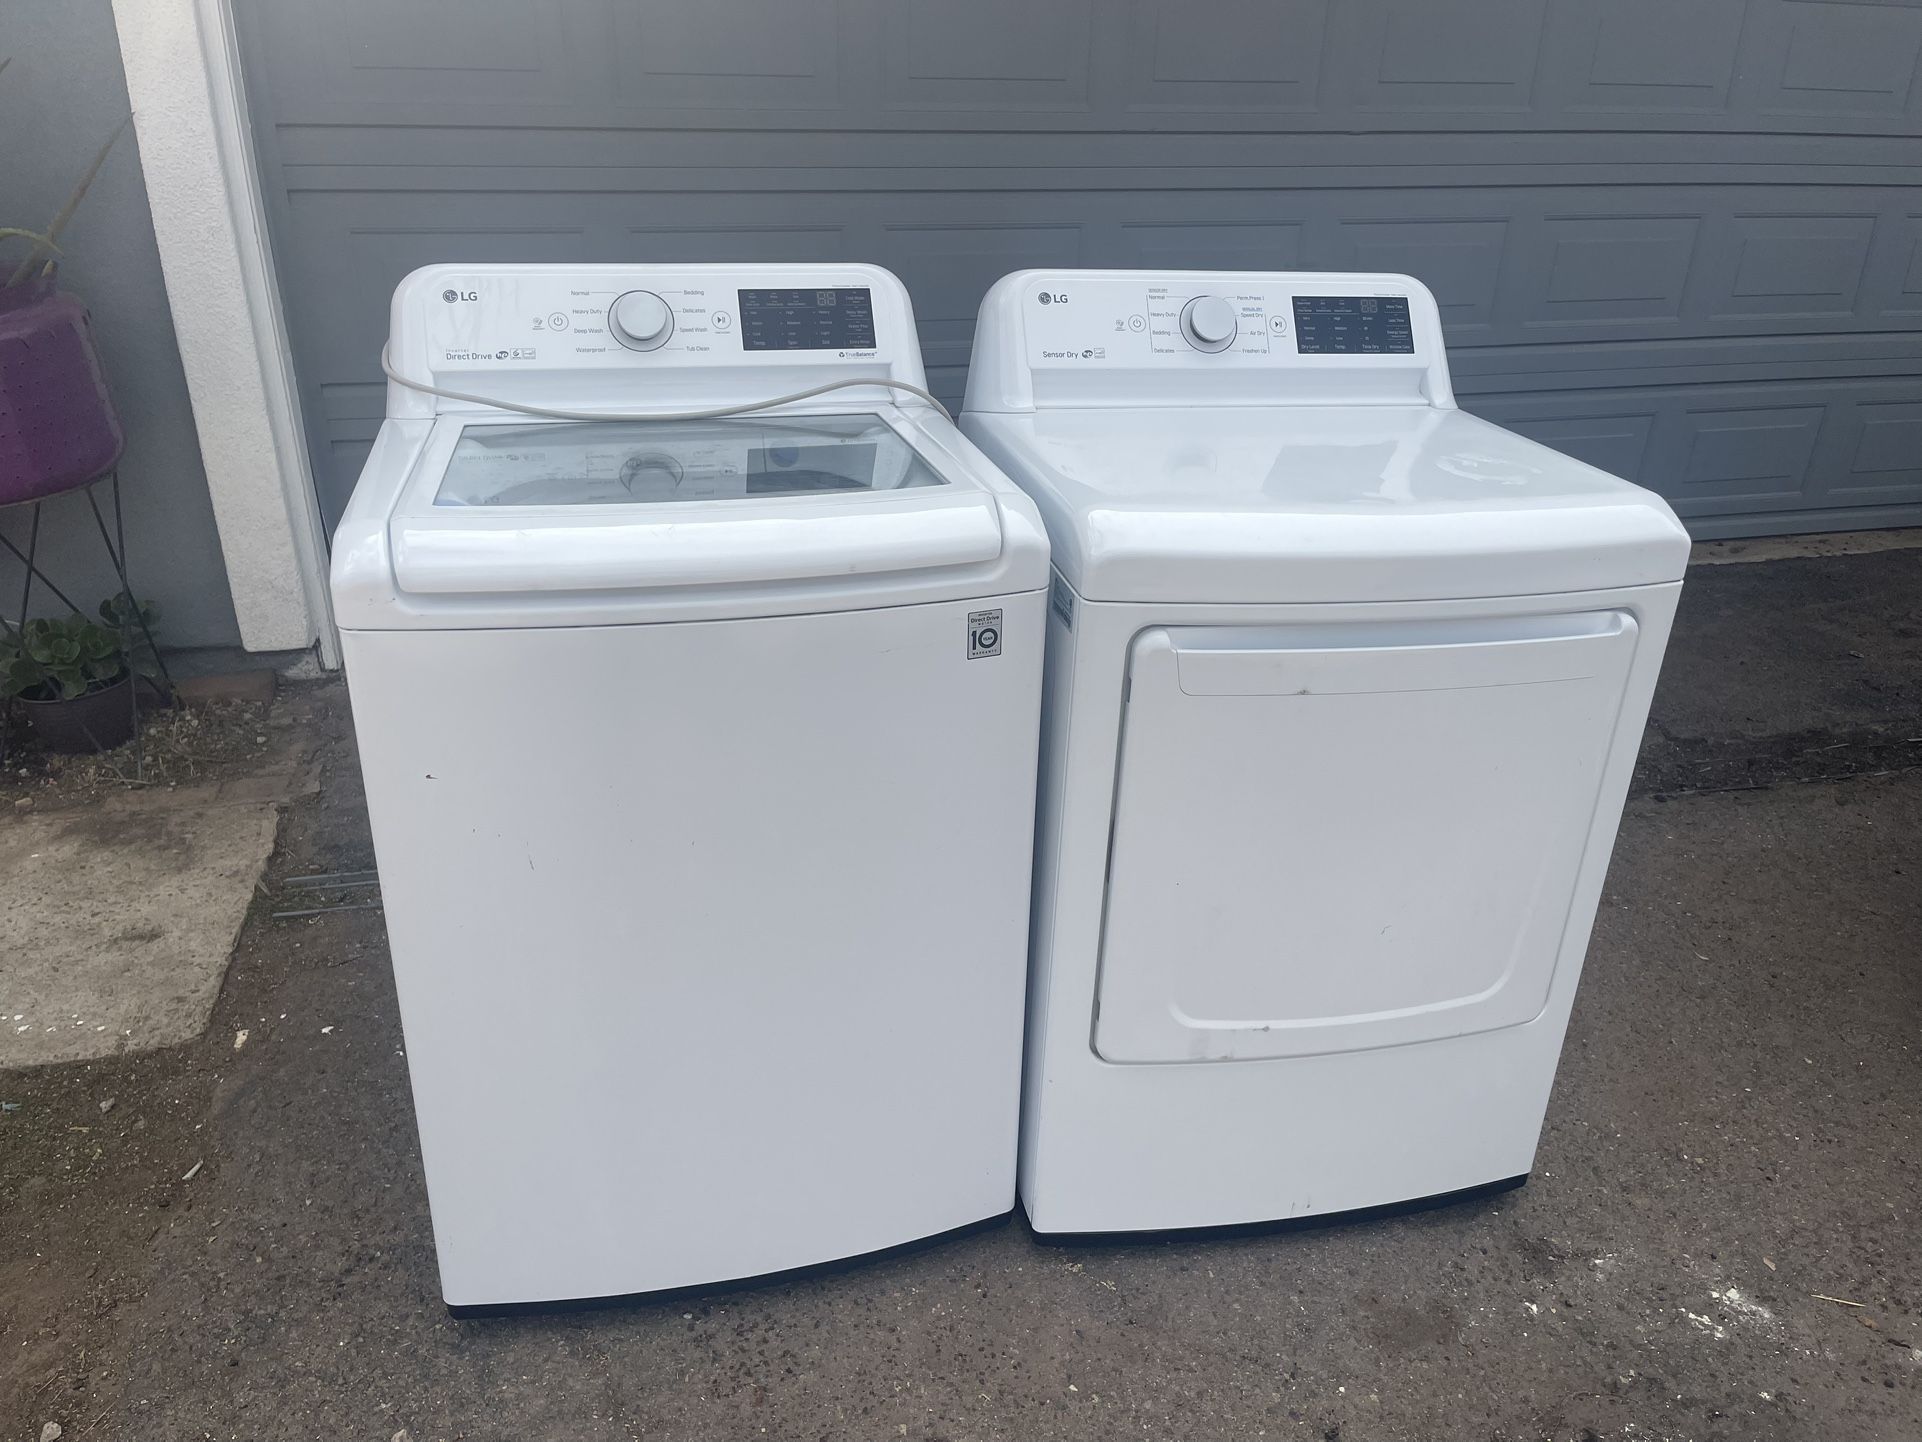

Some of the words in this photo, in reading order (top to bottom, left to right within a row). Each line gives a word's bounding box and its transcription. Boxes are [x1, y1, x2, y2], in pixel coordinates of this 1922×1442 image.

[460, 291, 478, 302] LG
[1053, 294, 1068, 304] LG
[446, 352, 470, 360] Direct
[472, 352, 492, 360] Drive
[1067, 351, 1079, 359] Dry
[971, 628, 998, 650] 10
